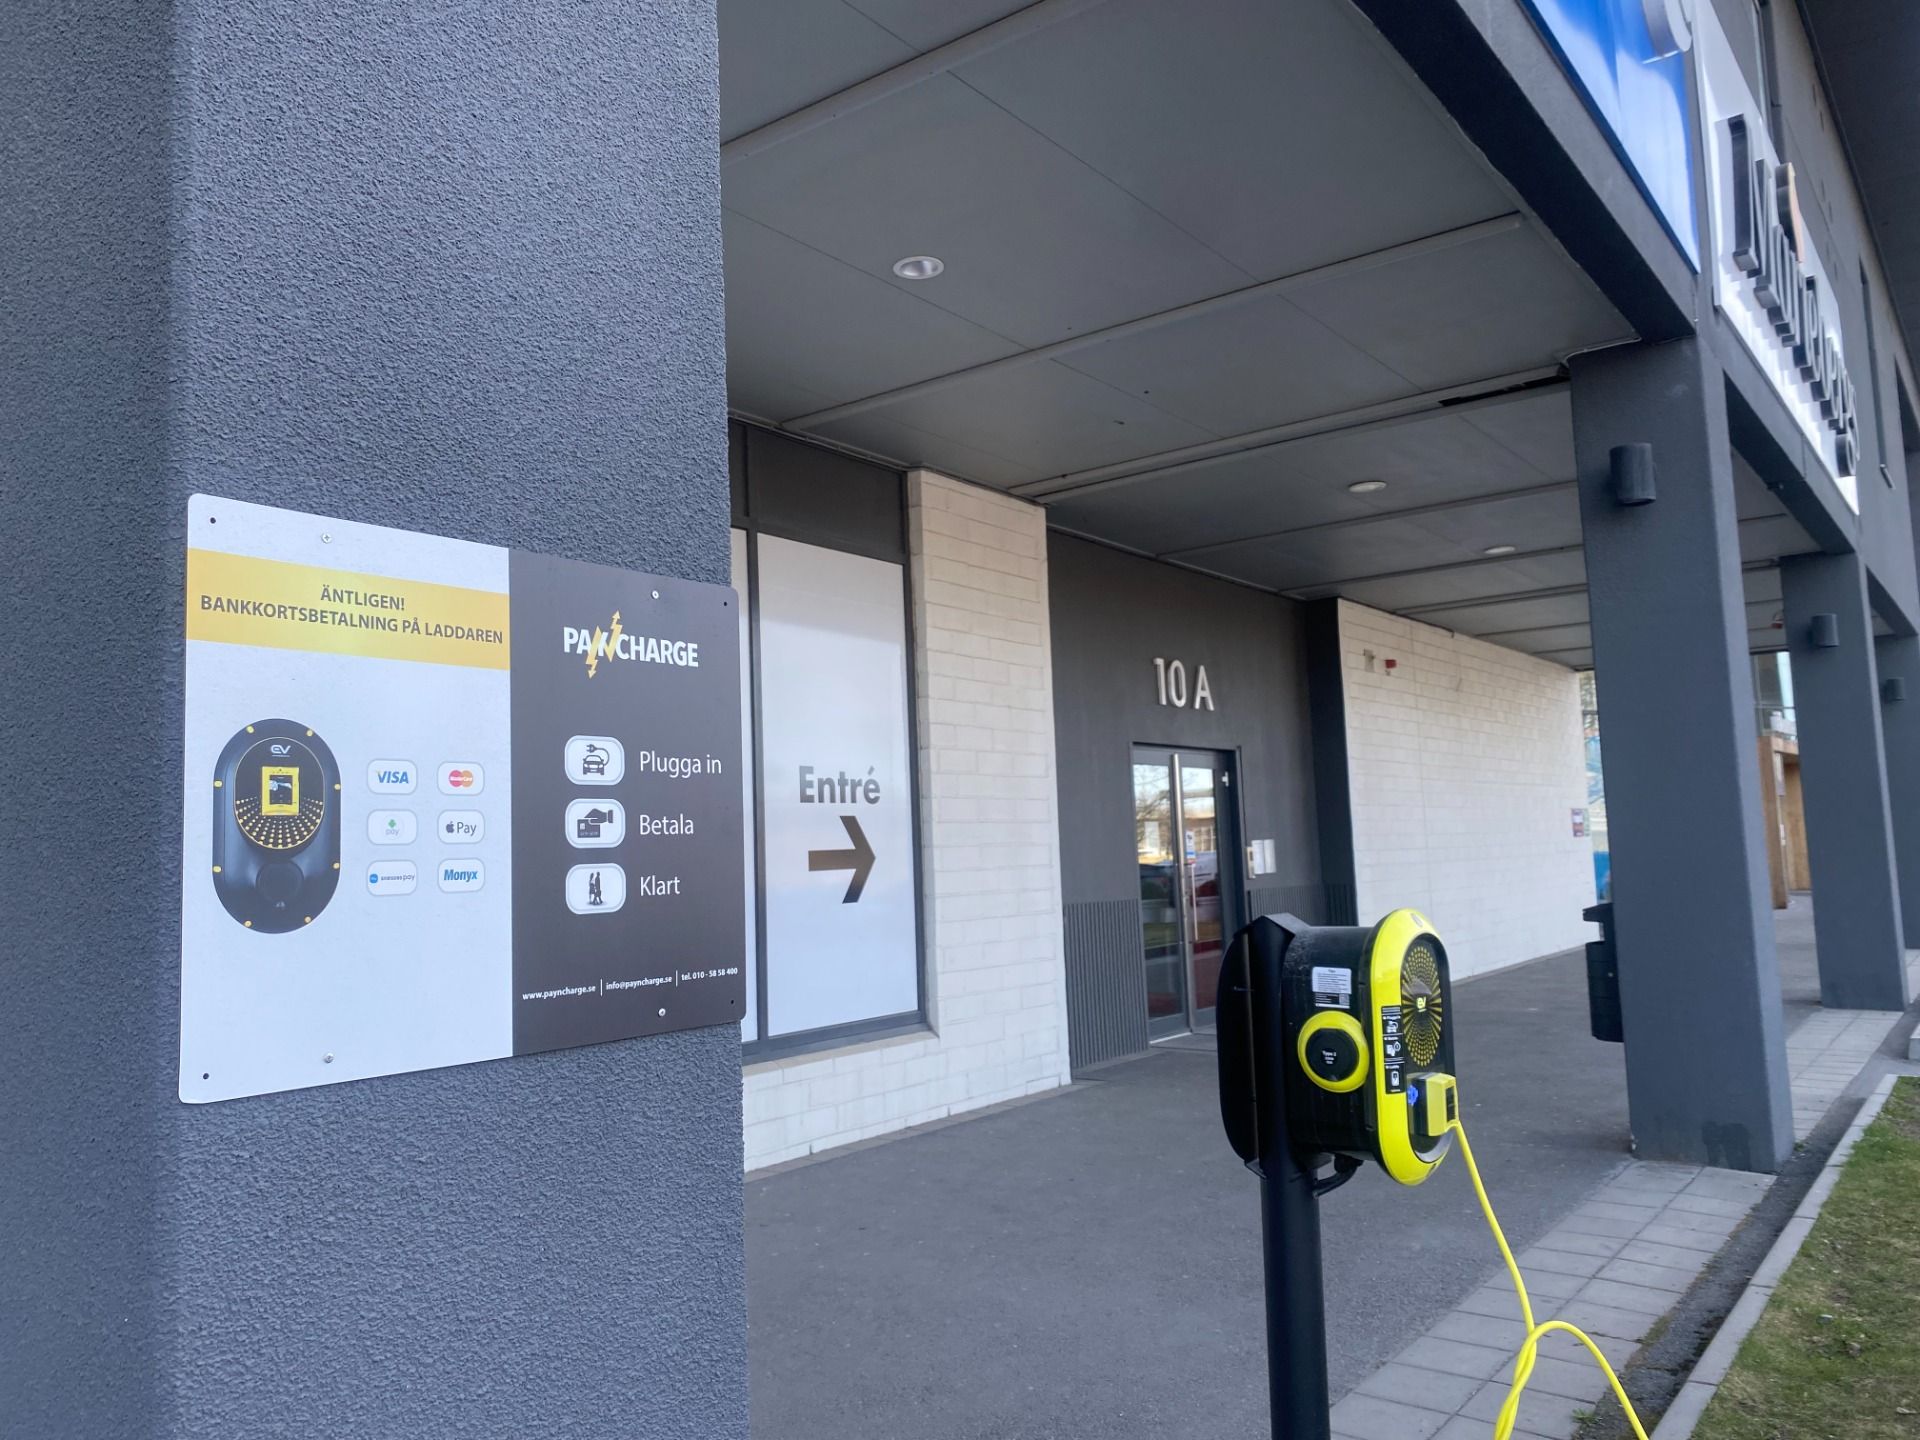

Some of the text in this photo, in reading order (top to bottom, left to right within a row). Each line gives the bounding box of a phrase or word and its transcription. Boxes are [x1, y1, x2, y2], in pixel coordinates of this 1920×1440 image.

[320, 584, 405, 611] ÄNTLIGEN!
[200, 594, 503, 644] BANKKORTSBETALNING PÅ LADDAREN
[1152, 657, 1215, 711] 10 A
[377, 771, 409, 784] VISA
[639, 750, 722, 779] Plugga in
[799, 765, 881, 805] Entré
[456, 821, 477, 836] Pay
[639, 813, 694, 835] Betala
[443, 869, 478, 883] Monyx
[640, 875, 681, 896] Klart
[522, 985, 596, 1000] www.payncharge.se
[606, 976, 672, 990] info@payncharge.se
[681, 973, 692, 981] tel.
[692, 971, 704, 980] 010
[709, 970, 717, 978] 58
[726, 967, 738, 975] 400
